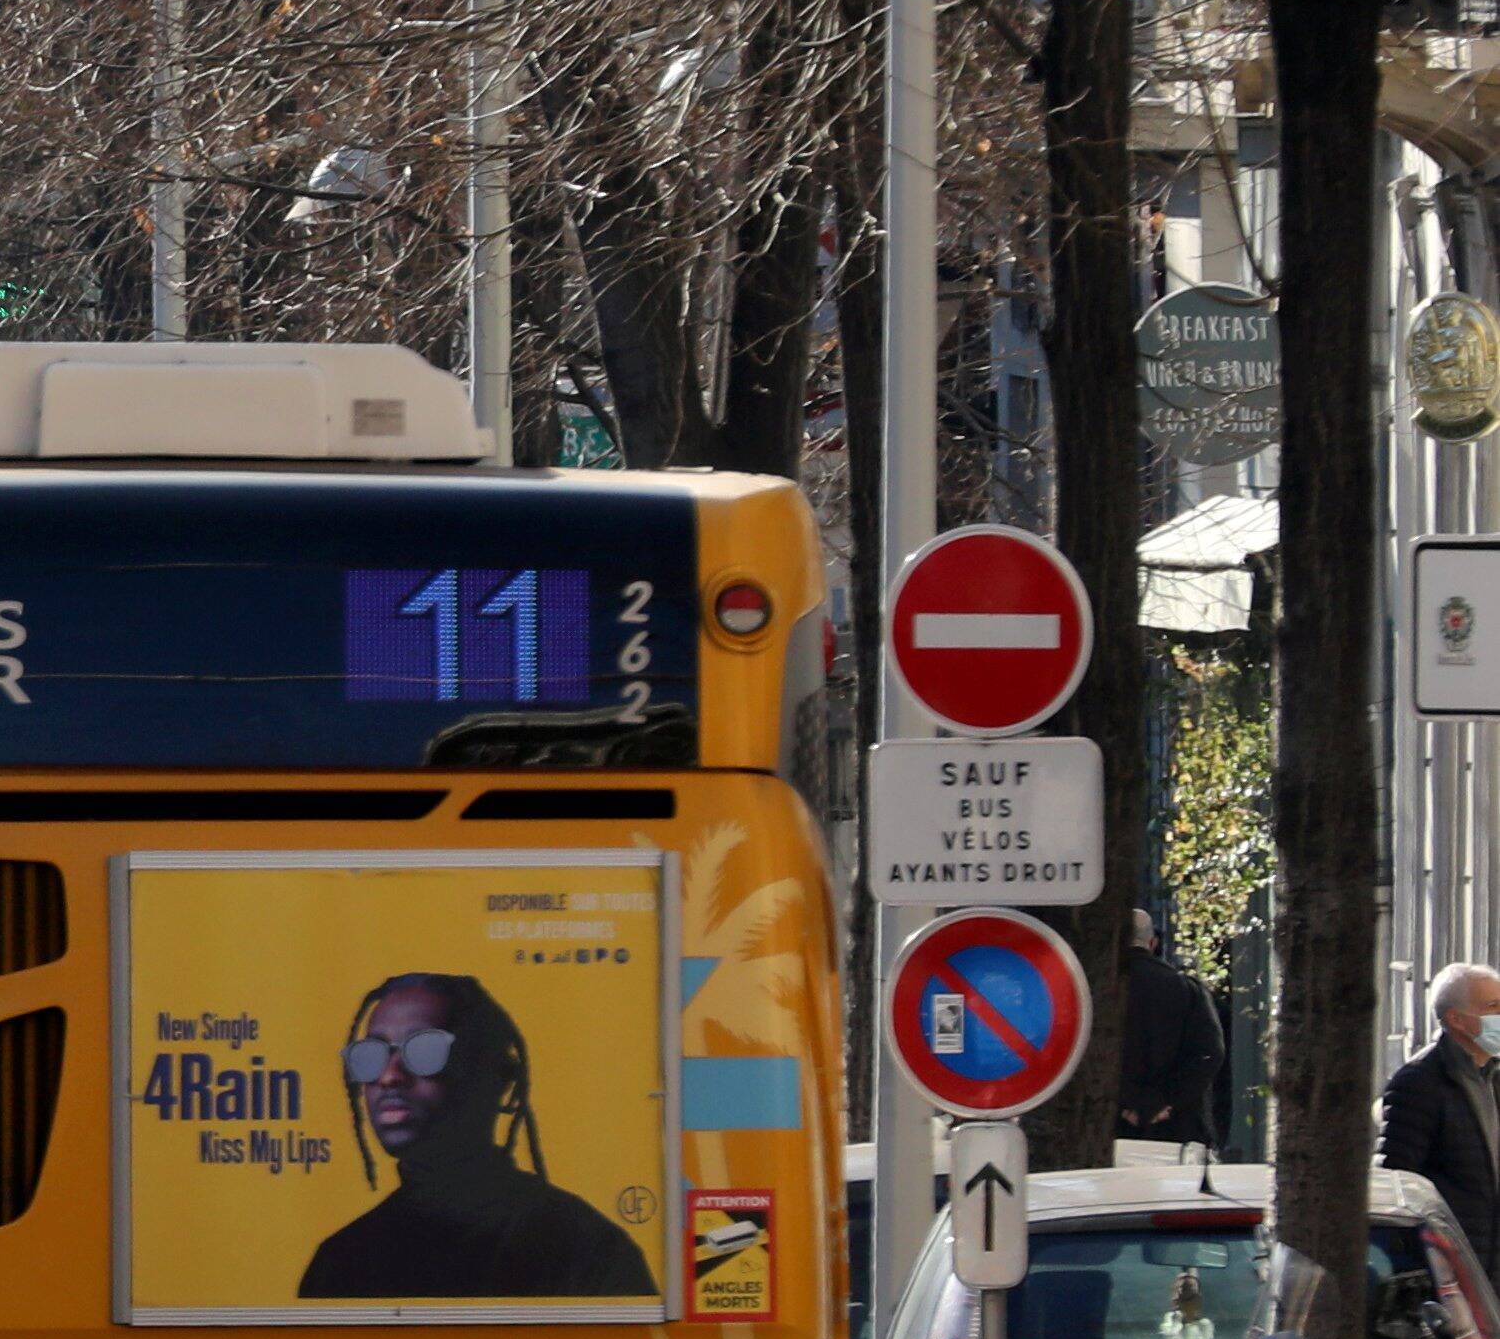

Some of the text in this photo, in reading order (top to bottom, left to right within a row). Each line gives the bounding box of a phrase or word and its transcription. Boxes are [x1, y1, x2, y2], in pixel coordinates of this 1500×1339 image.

[1158, 314, 1270, 342] BREAKFAST
[399, 568, 538, 701] 11
[940, 761, 1031, 786] SAUF
[959, 798, 1013, 818] BUS
[942, 827, 1032, 851] VÉLOS
[889, 862, 1084, 883] AYANTS DROIT
[158, 1012, 259, 1050] New Single
[143, 1052, 301, 1121] 4Rain
[200, 1129, 332, 1174] Kiss My Lips
[695, 1196, 771, 1208] ATTENTION
[703, 1281, 763, 1294] ANGLES
[705, 1295, 761, 1309] MORTS
